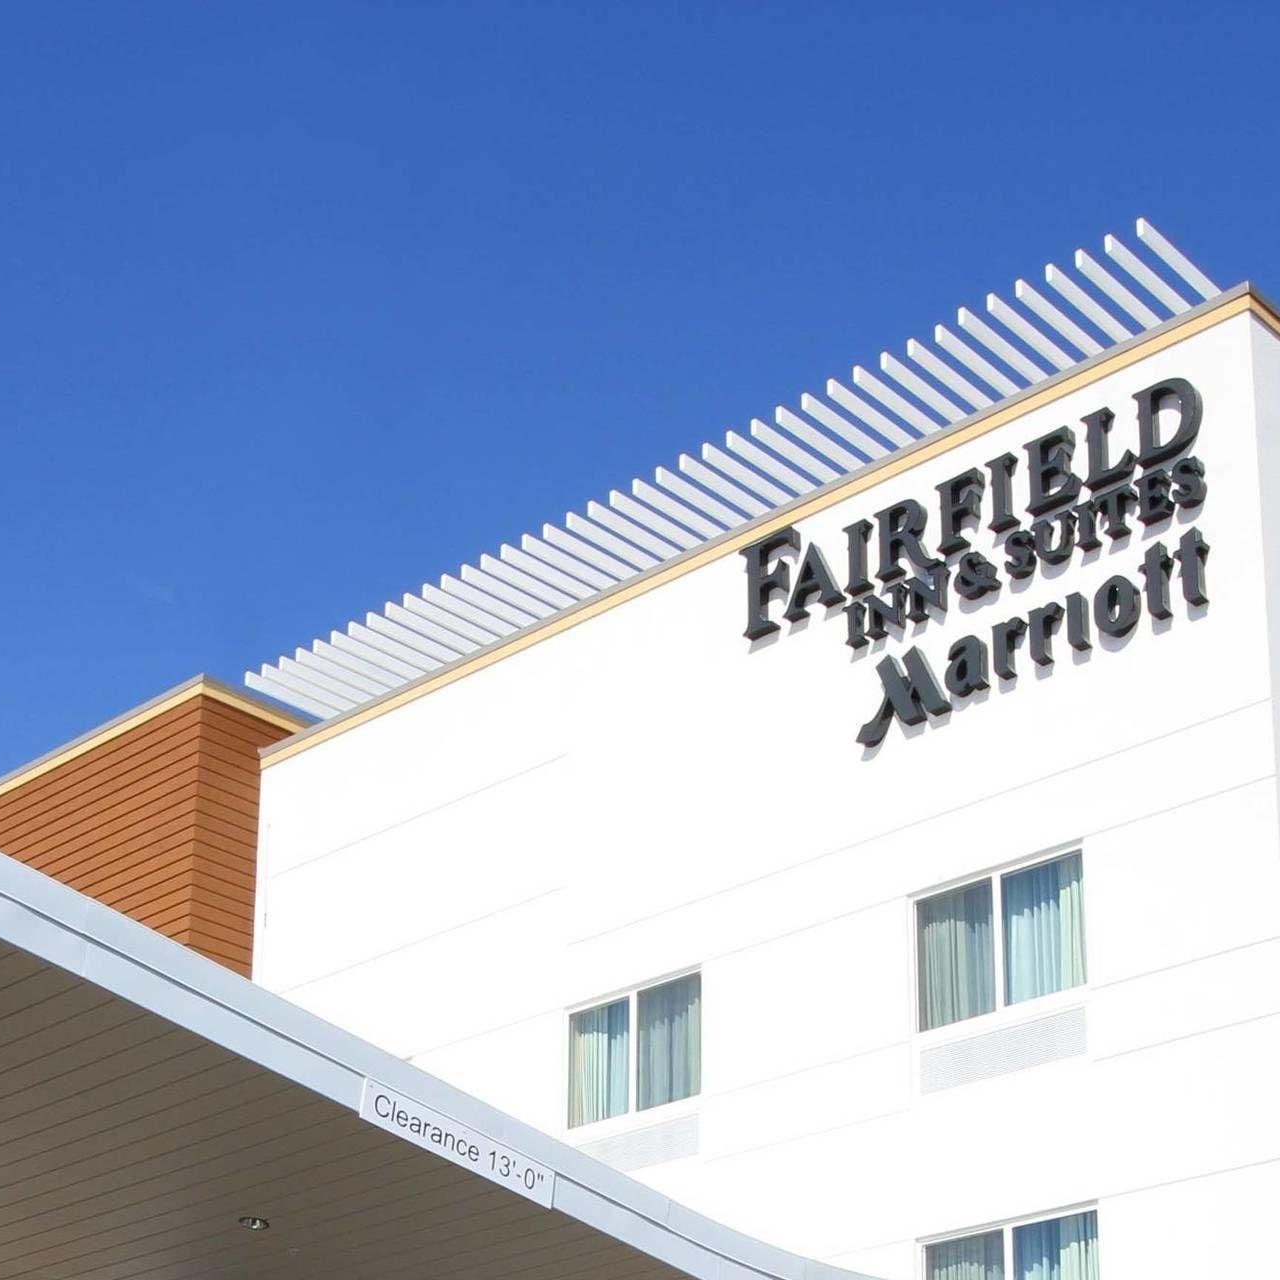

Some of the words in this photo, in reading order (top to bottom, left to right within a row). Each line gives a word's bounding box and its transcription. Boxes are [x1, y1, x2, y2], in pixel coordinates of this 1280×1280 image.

[738, 377, 1204, 642] FAIRFIELD
[842, 558, 951, 650] INN
[954, 550, 1002, 601] &
[1004, 456, 1208, 580] SUITES
[855, 526, 1210, 748] Marriott
[374, 1094, 480, 1162] Clearance
[489, 1151, 545, 1190] 13'-0"
